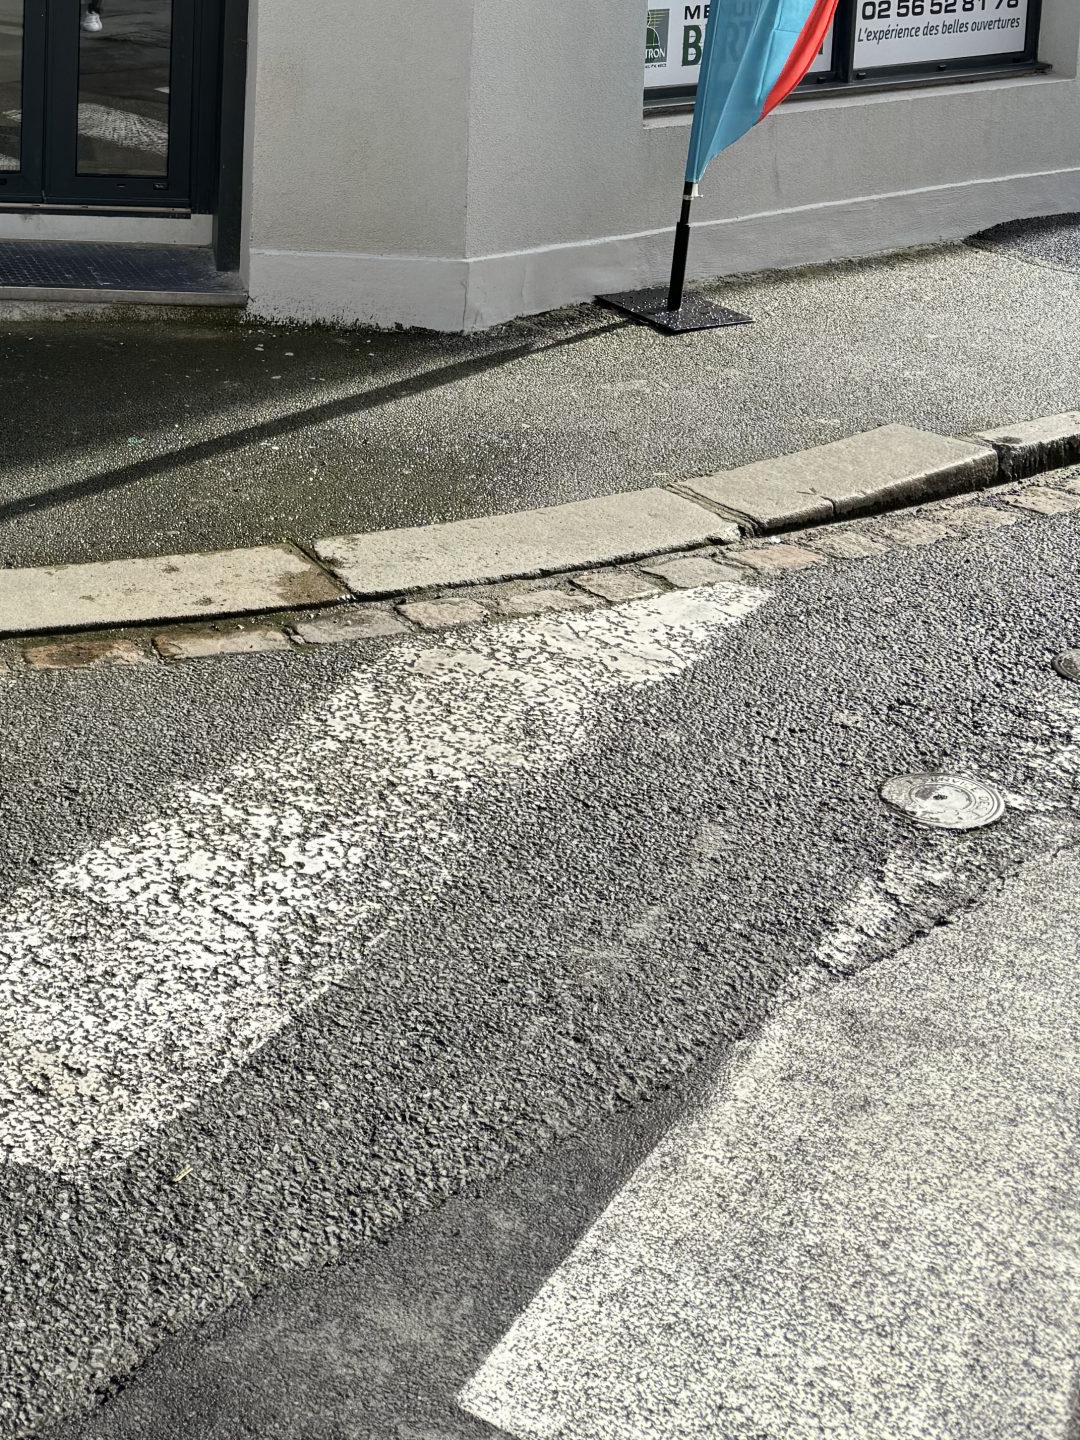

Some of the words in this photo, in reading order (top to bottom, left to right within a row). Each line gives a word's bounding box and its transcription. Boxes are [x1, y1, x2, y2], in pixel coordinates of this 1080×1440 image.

[861, 0, 891, 20] 02
[857, 23, 920, 45] L'expérience
[922, 21, 940, 36] des
[941, 19, 969, 35] belles
[971, 17, 1021, 32] ouvertures
